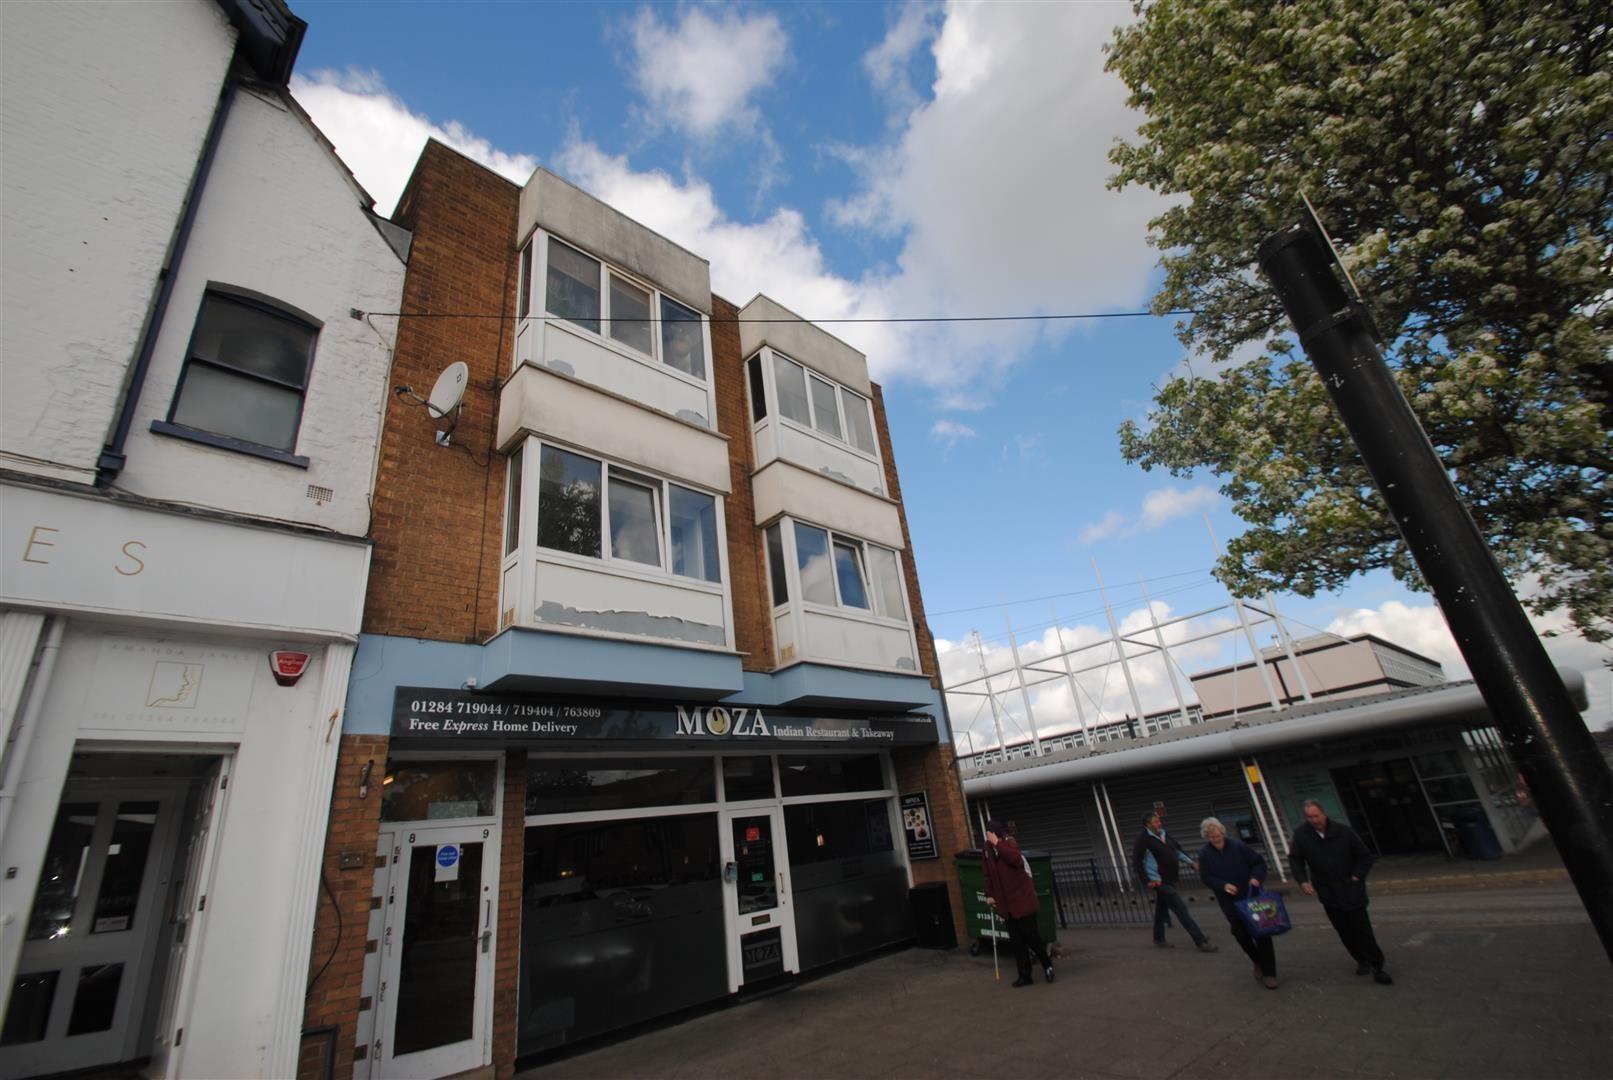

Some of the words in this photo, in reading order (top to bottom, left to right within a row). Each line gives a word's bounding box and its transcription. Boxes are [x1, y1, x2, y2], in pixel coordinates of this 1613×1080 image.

[411, 700, 452, 714] 01284
[457, 702, 502, 715] 719044
[513, 704, 554, 717] 719404
[564, 706, 601, 719] 763809
[409, 718, 440, 731] Free
[442, 719, 489, 735] Express
[492, 720, 529, 733] Home
[532, 721, 578, 736] Delivery
[675, 705, 771, 737] MOZA
[773, 725, 804, 737] Indian
[805, 726, 850, 739] Restaurant
[851, 728, 859, 738] &
[862, 727, 895, 741] Takeaway
[408, 833, 416, 844] 8
[482, 829, 489, 839] 9
